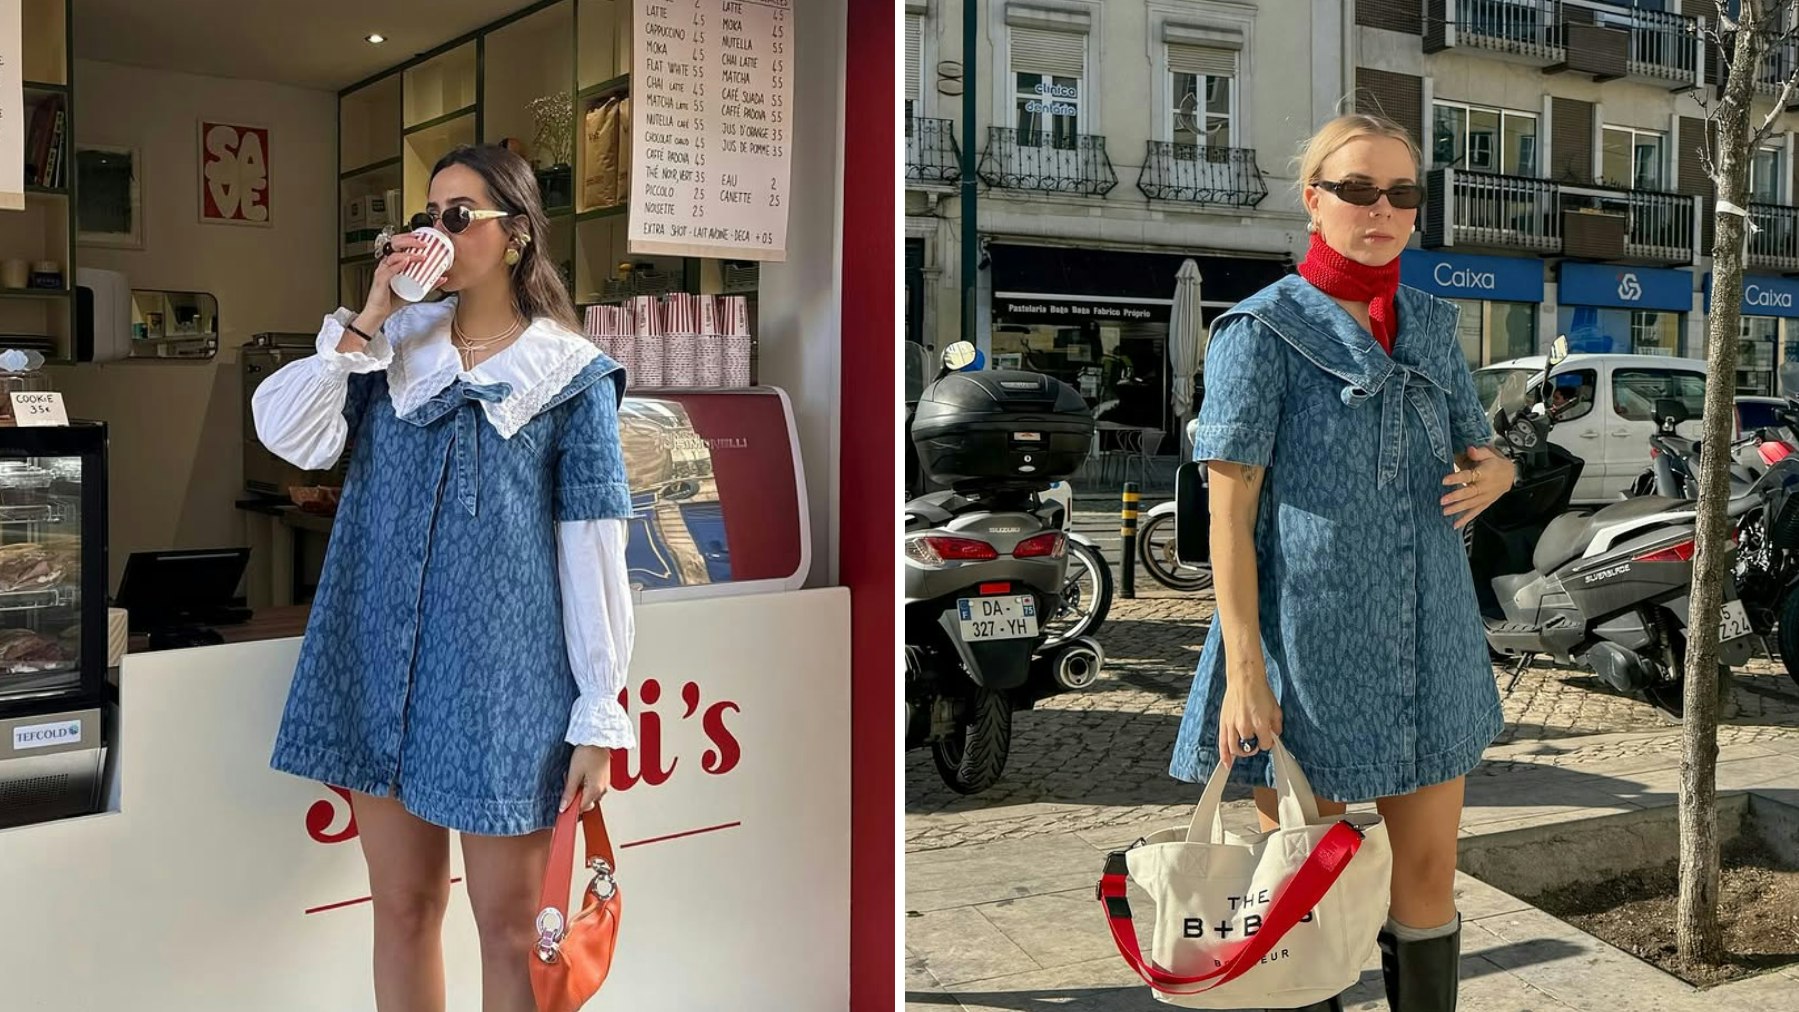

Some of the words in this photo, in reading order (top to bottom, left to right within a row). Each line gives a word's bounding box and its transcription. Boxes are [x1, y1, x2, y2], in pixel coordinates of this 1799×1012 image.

[646, 5, 668, 19] LATTE
[722, 1, 743, 15] LATTE
[645, 22, 686, 41] CAPPUCCINO
[722, 18, 743, 32] MOKA
[646, 40, 668, 55] MOKA
[722, 35, 753, 51] NUTELLA
[646, 57, 663, 73] FLAT
[667, 61, 689, 77] WHITE
[721, 52, 737, 66] CHAI
[739, 55, 759, 69] LATTE
[646, 75, 663, 91] CHAI
[721, 69, 750, 84] MATCHA
[646, 93, 674, 110] MATCHA
[646, 113, 674, 127] NUTELLA
[721, 122, 737, 136] JUS
[721, 139, 737, 153] JUS
[740, 141, 748, 153] DE
[721, 173, 738, 188] EAU
[771, 176, 778, 191] 2
[645, 183, 674, 198] PICCOLO
[720, 189, 752, 205] CANETTE
[645, 202, 675, 216] NOISETTE
[643, 222, 665, 235] EXTRA
[670, 224, 688, 237] SHOT
[1434, 262, 1495, 289] Caixa
[1745, 284, 1793, 308] Caixa
[1008, 304, 1047, 313] Pastelaria
[1093, 306, 1121, 316] Fabrico
[16, 394, 54, 404] COOKIE
[1024, 606, 1034, 615] 75
[16, 728, 67, 743] TEFCOLD
[1227, 889, 1270, 911] THE
